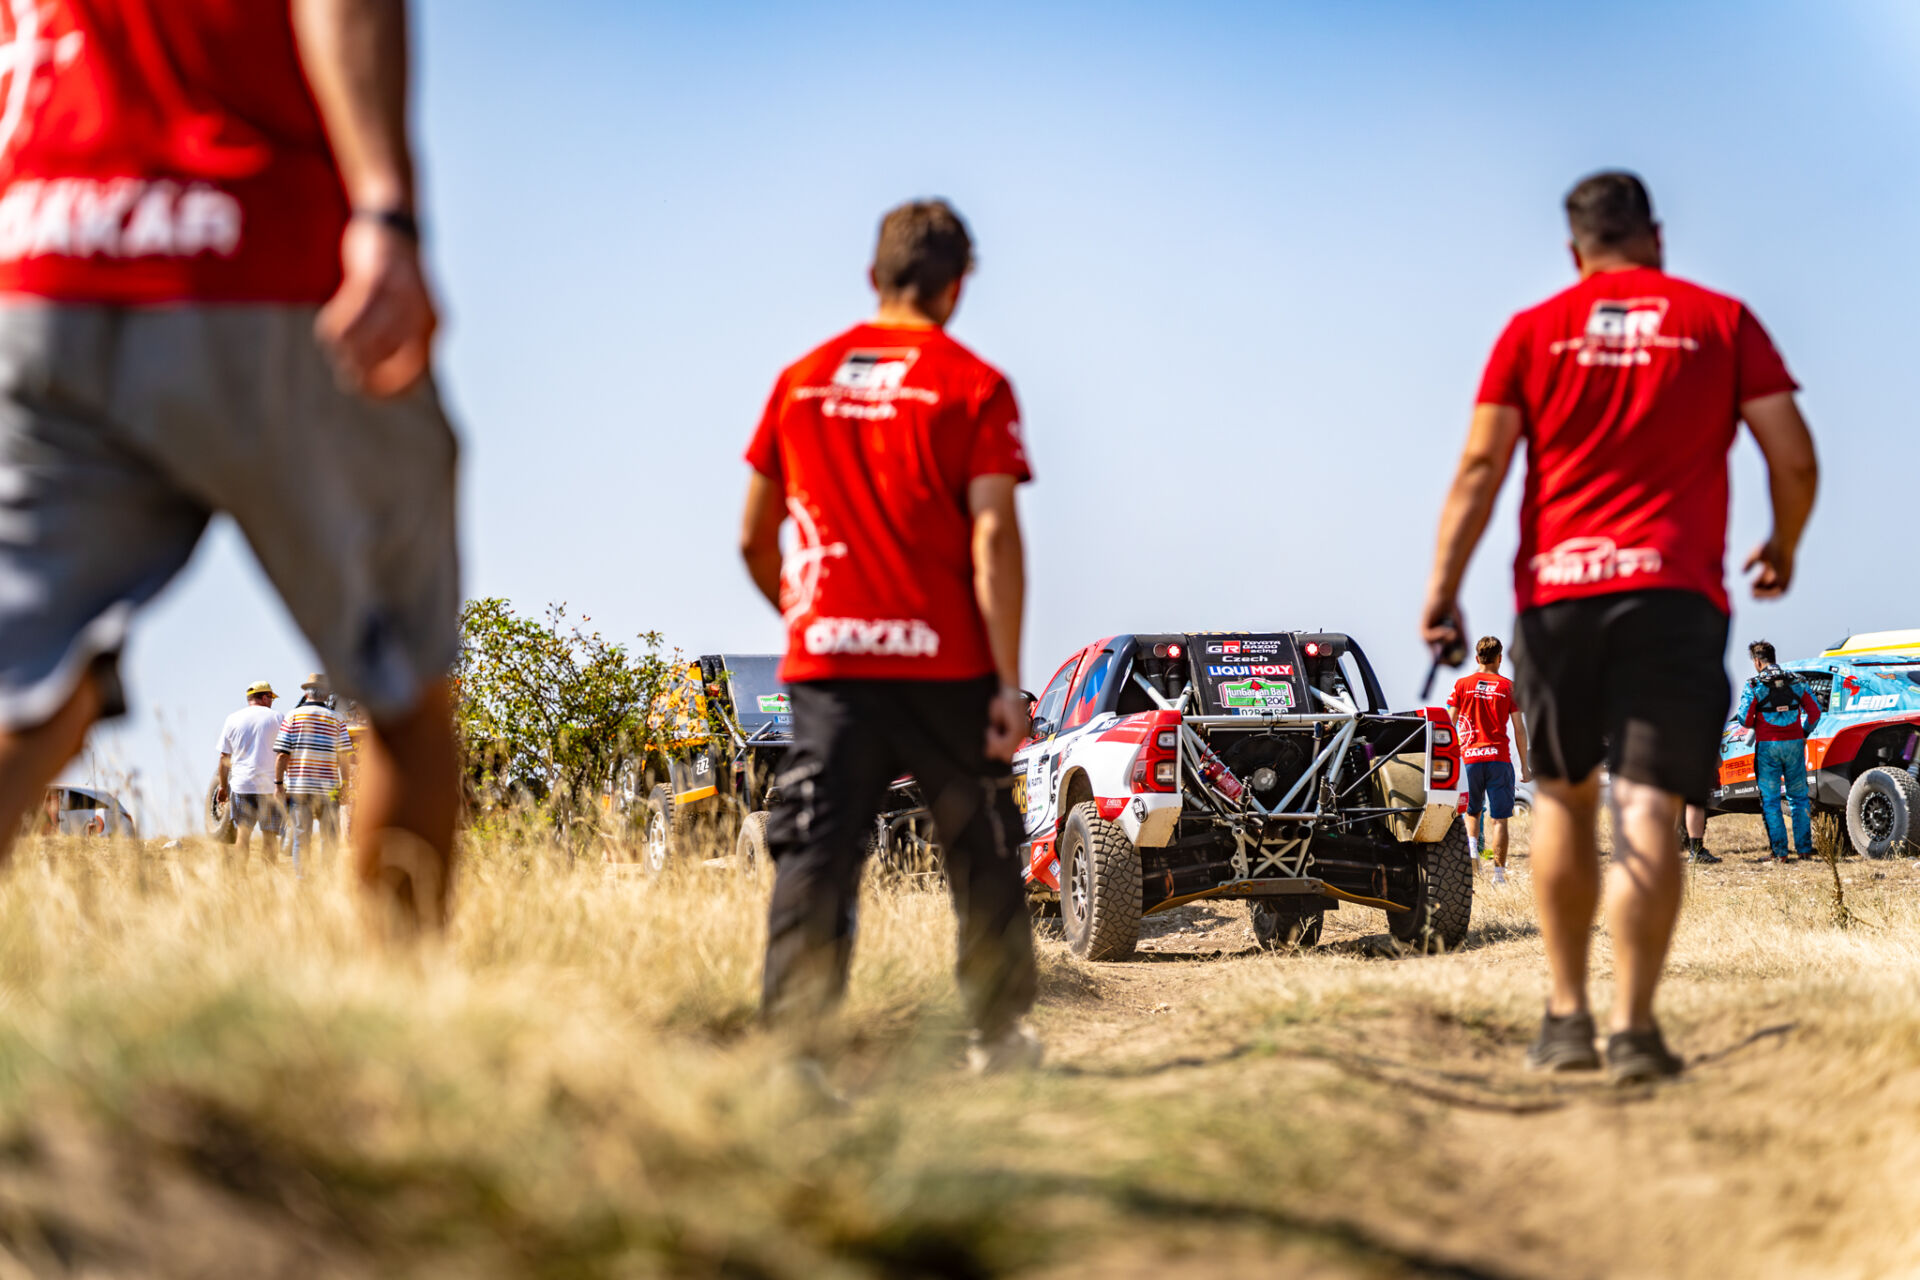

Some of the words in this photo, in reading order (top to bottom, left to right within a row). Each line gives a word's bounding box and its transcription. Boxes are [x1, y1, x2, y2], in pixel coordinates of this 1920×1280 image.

[1207, 645, 1240, 653] GR
[1209, 666, 1249, 676] LIQUI
[1252, 665, 1290, 675] MOLY
[1267, 697, 1286, 705] 206
[1464, 748, 1498, 757] DAKAR
